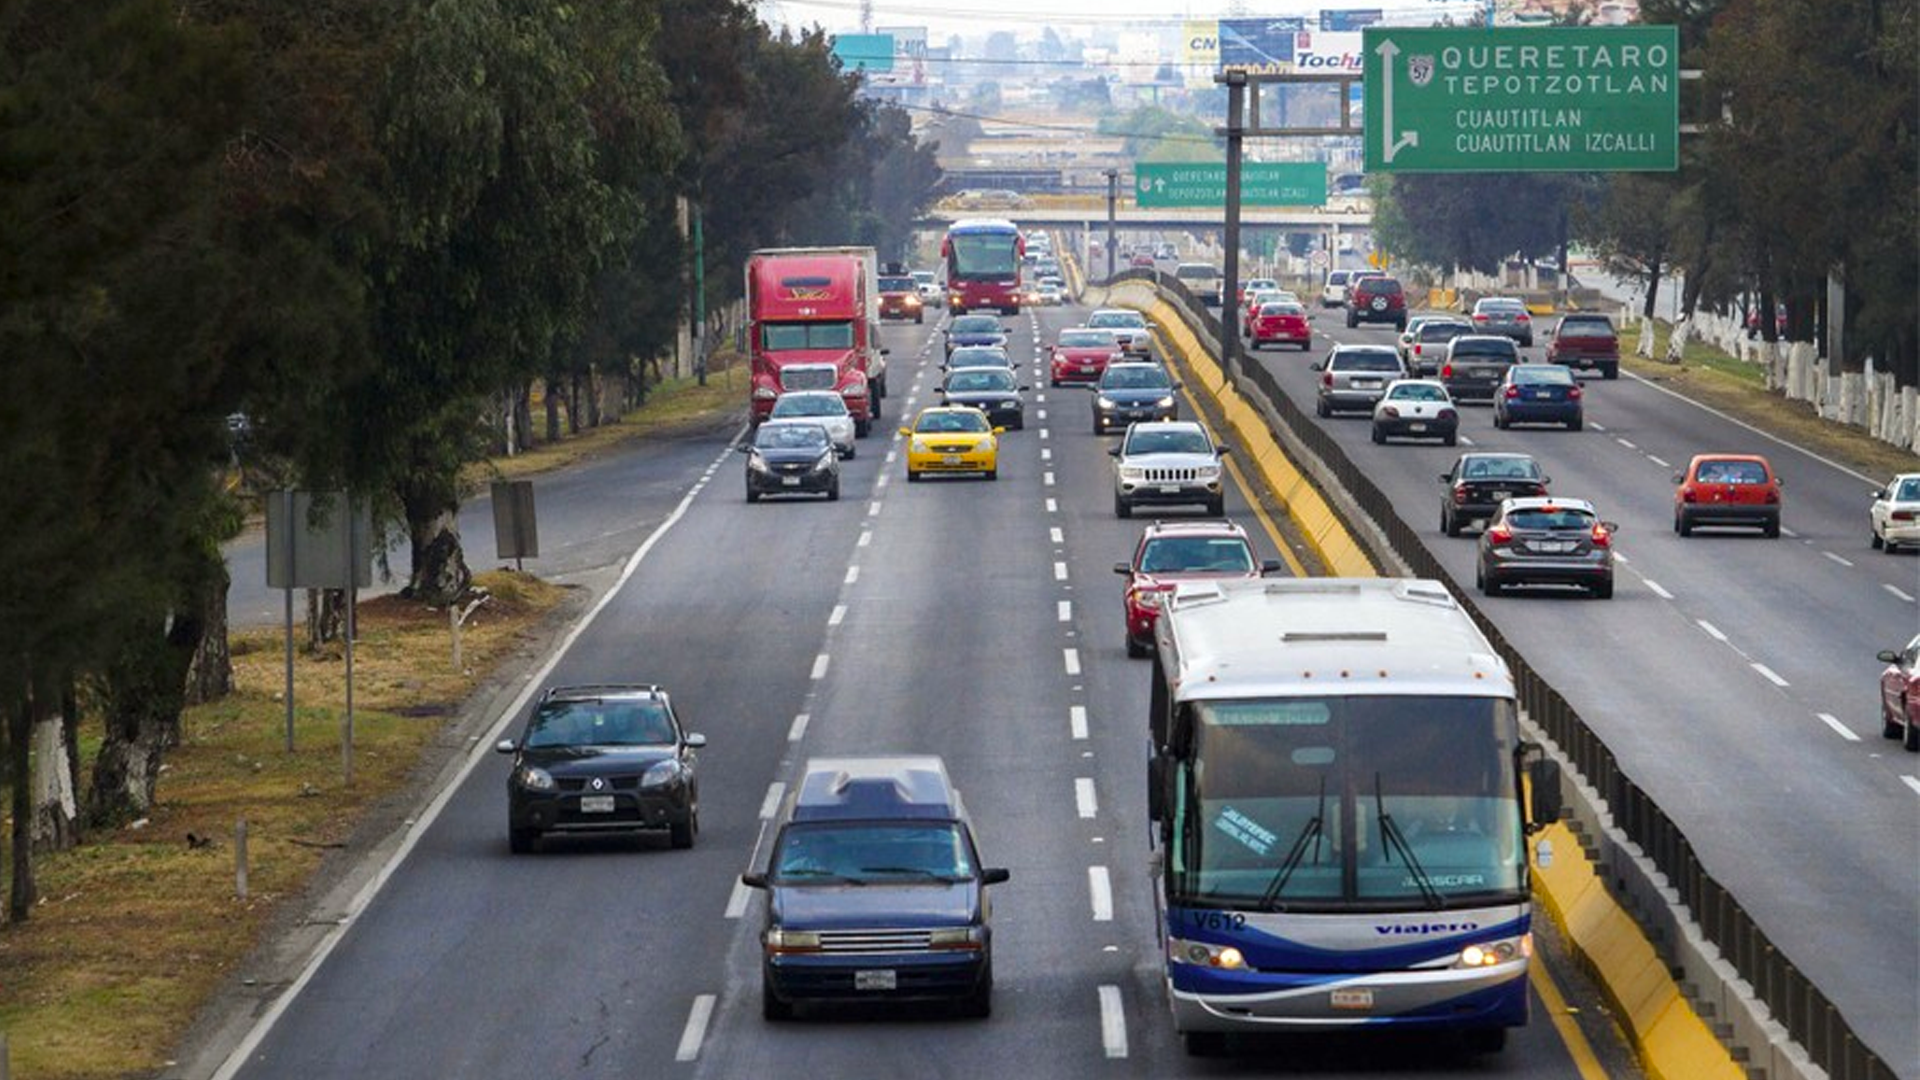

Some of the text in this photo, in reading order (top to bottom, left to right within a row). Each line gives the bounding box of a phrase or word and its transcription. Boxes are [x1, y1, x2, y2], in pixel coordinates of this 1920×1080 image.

[1442, 45, 1668, 70] QUERETARO
[1413, 65, 1429, 81] 57
[1444, 75, 1668, 95] TEPOTZOTLAN
[1456, 109, 1582, 128] CUAUTITLAN
[1456, 133, 1655, 152] CUAUTITLAN IZCALLI
[1193, 911, 1246, 932] V612
